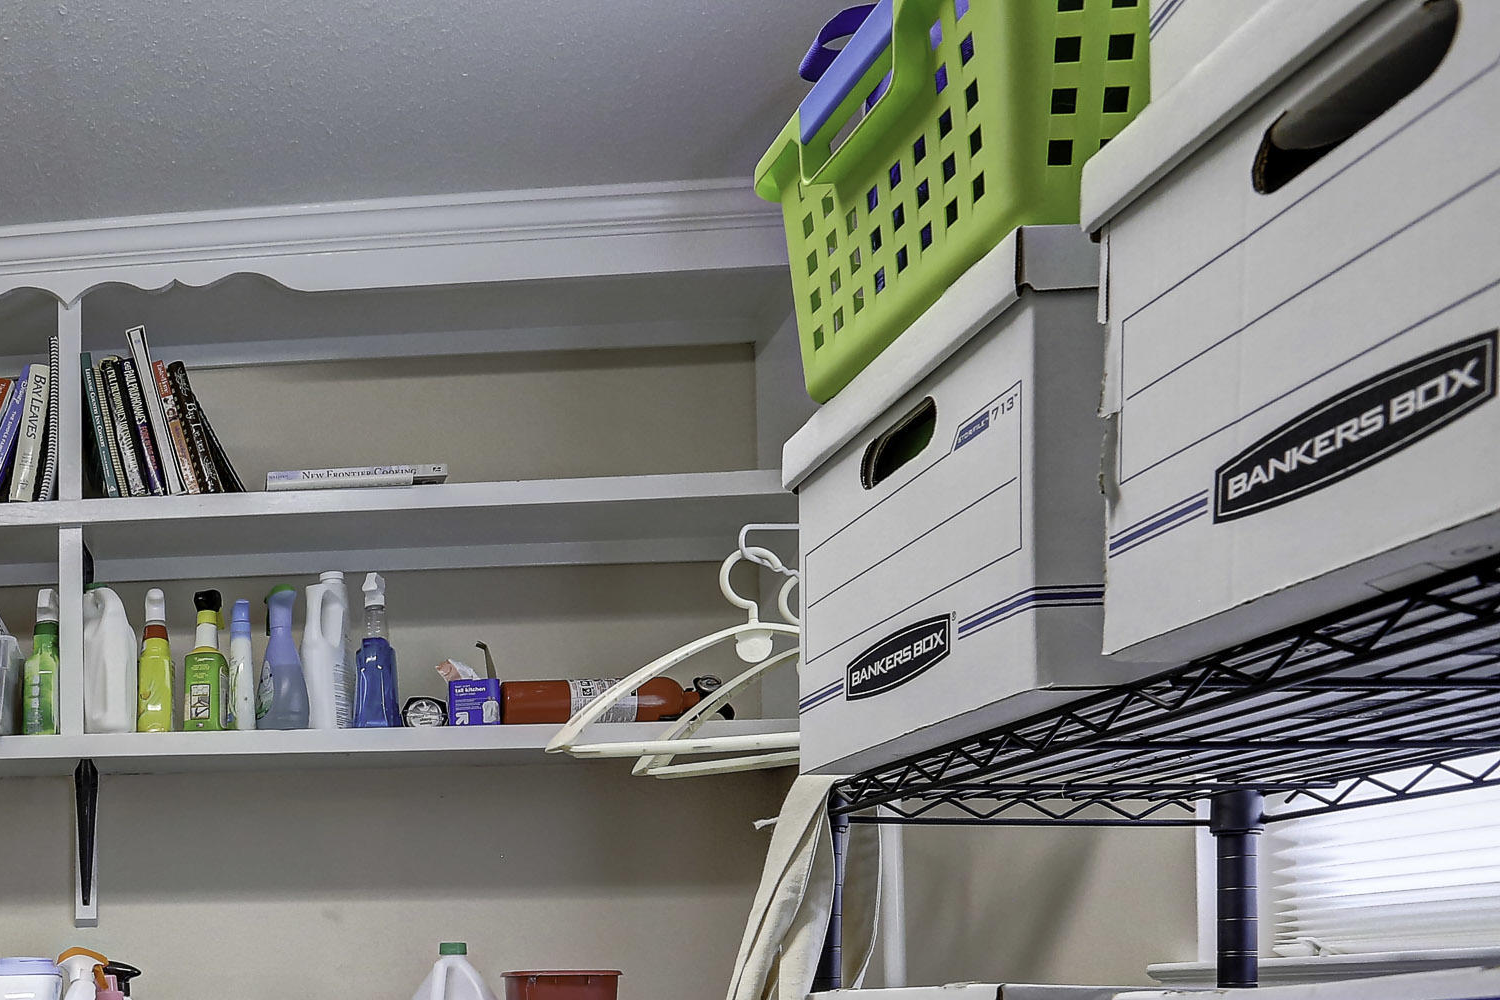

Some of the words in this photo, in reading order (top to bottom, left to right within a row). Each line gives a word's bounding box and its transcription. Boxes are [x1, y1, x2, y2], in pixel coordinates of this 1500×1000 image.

[32, 374, 47, 397] BAY
[124, 369, 136, 386] PAUL
[27, 397, 42, 440] LEAVES
[992, 396, 1015, 421] 713
[1228, 404, 1385, 501] BANKERS
[1389, 356, 1481, 425] BOX
[326, 469, 371, 479] FRONTIER
[374, 467, 417, 476] COOKING
[851, 644, 912, 687] BANKERS
[913, 628, 945, 658] BOX
